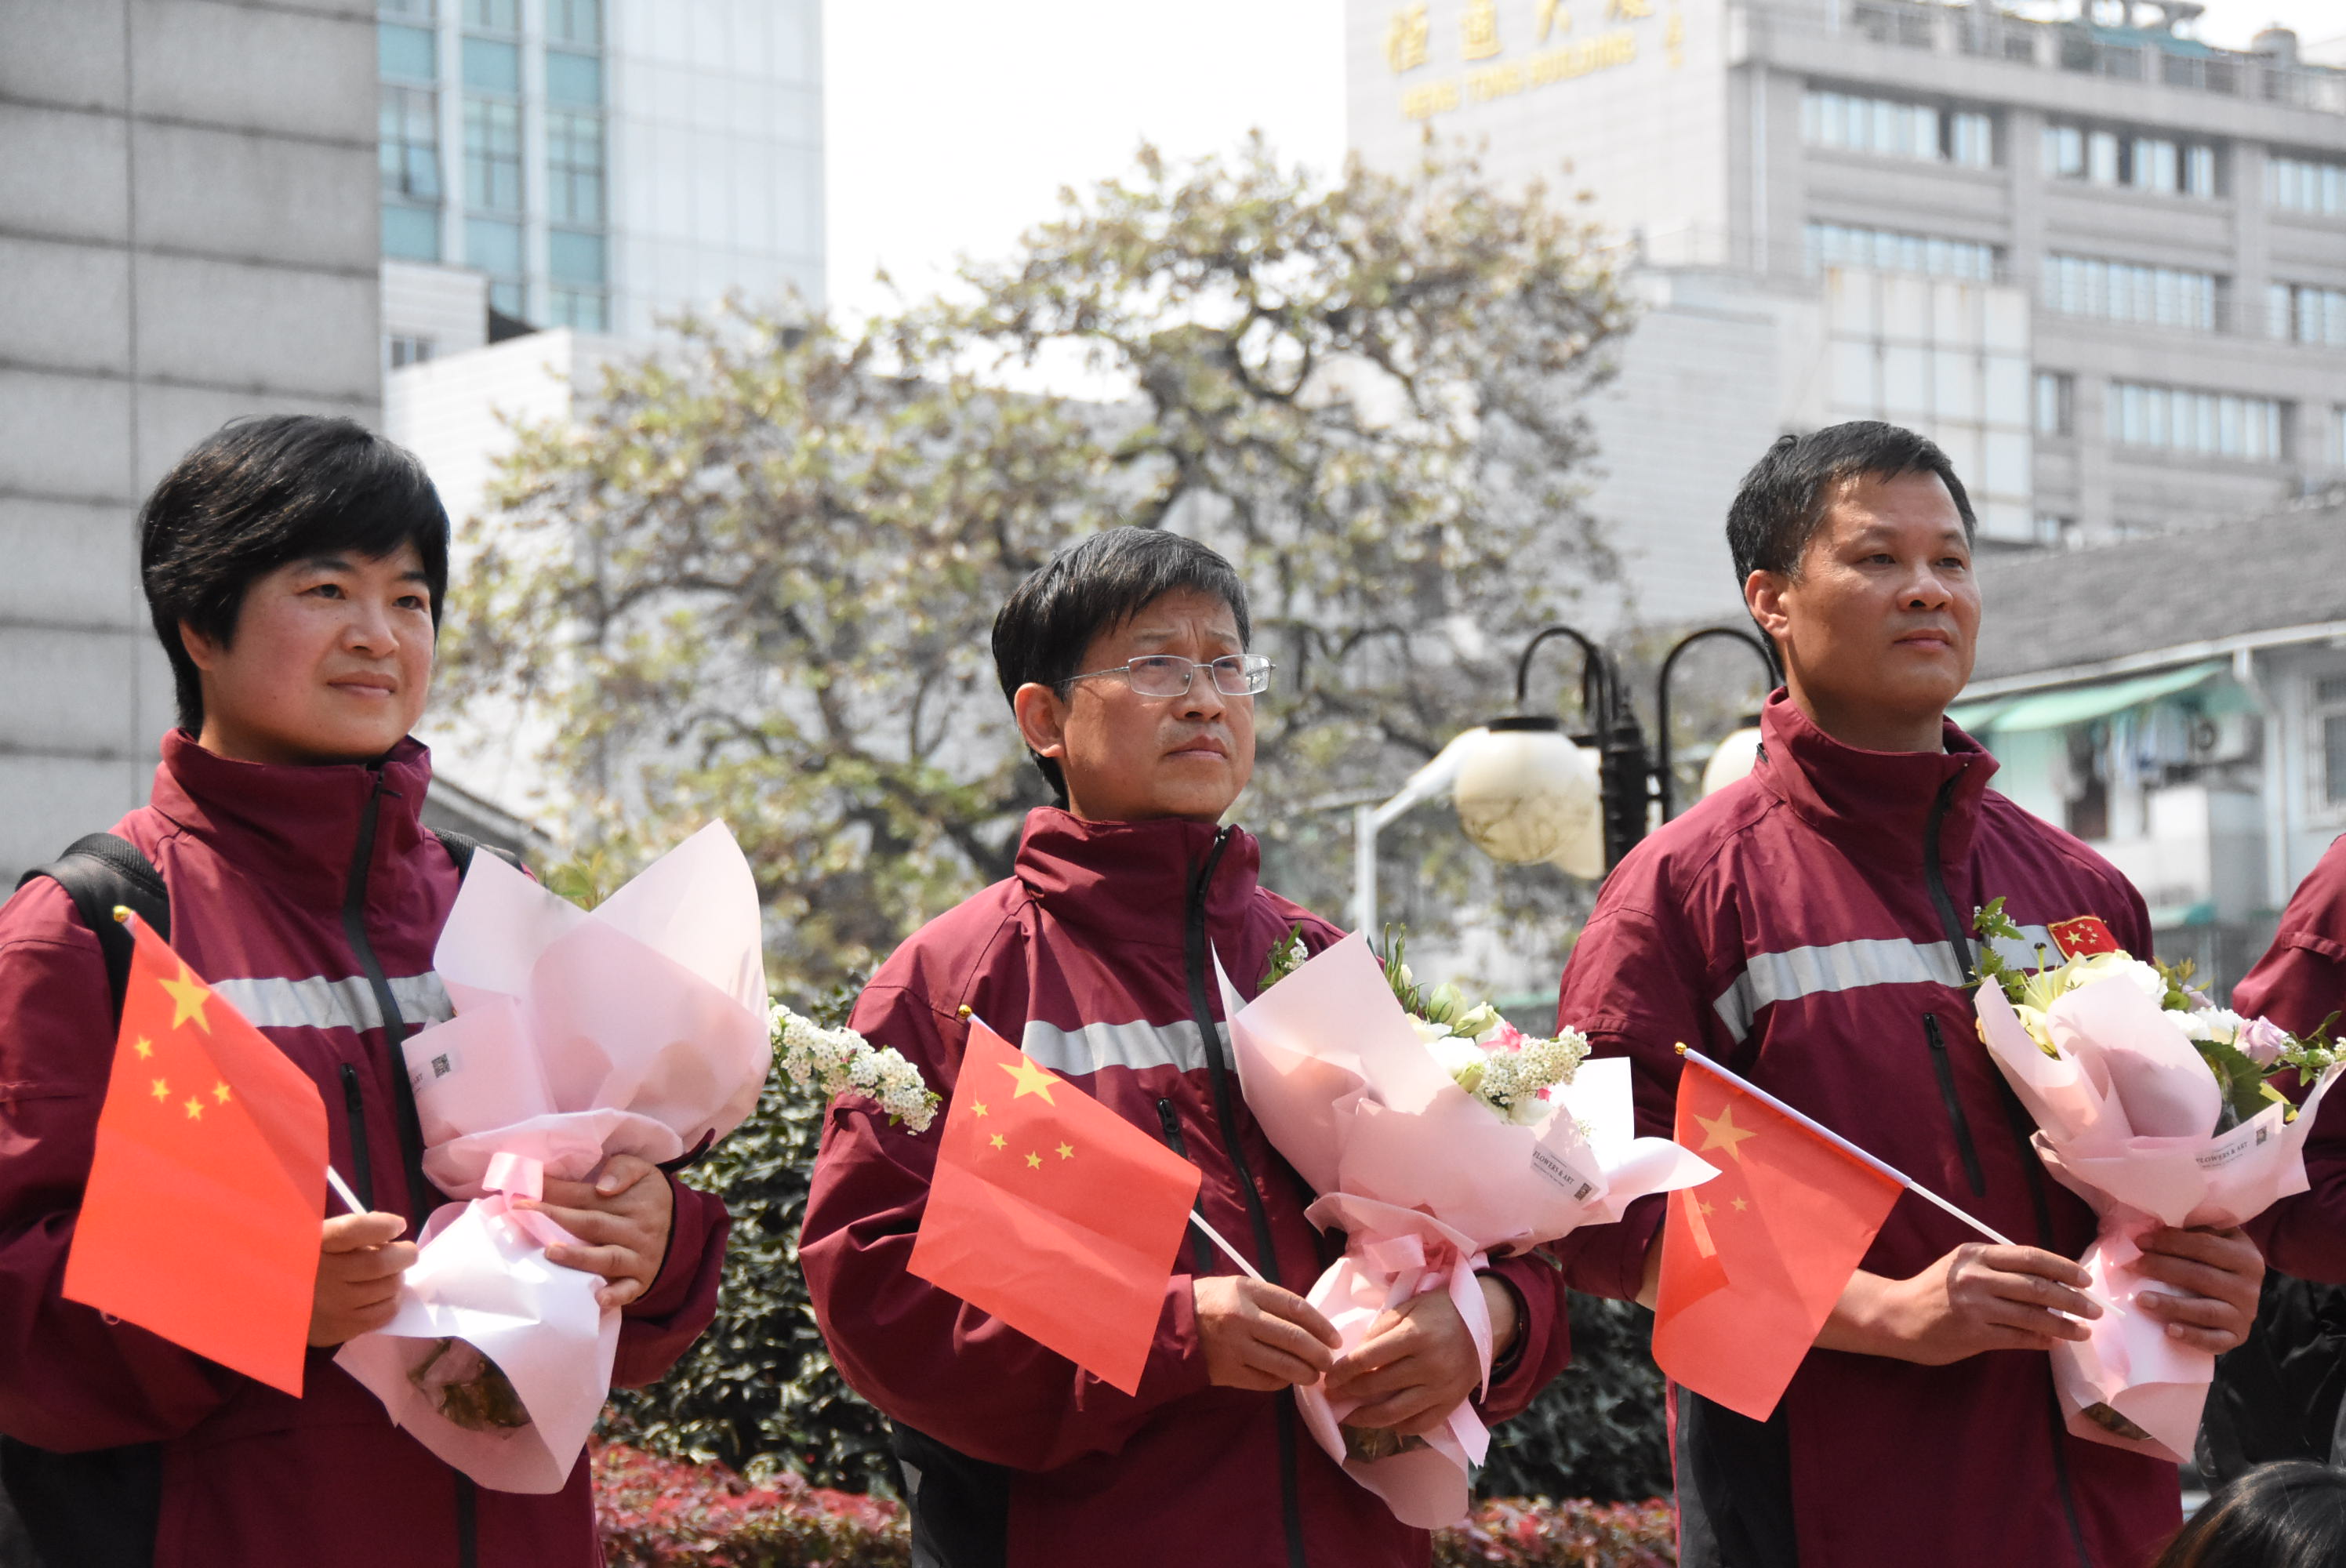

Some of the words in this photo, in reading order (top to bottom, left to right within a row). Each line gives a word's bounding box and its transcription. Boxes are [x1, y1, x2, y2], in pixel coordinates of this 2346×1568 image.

[1529, 31, 1636, 88] BUILDING
[2238, 1142, 2248, 1151] ART
[1533, 1151, 1559, 1173] FLOWERS
[1563, 1174, 1574, 1185] ART
